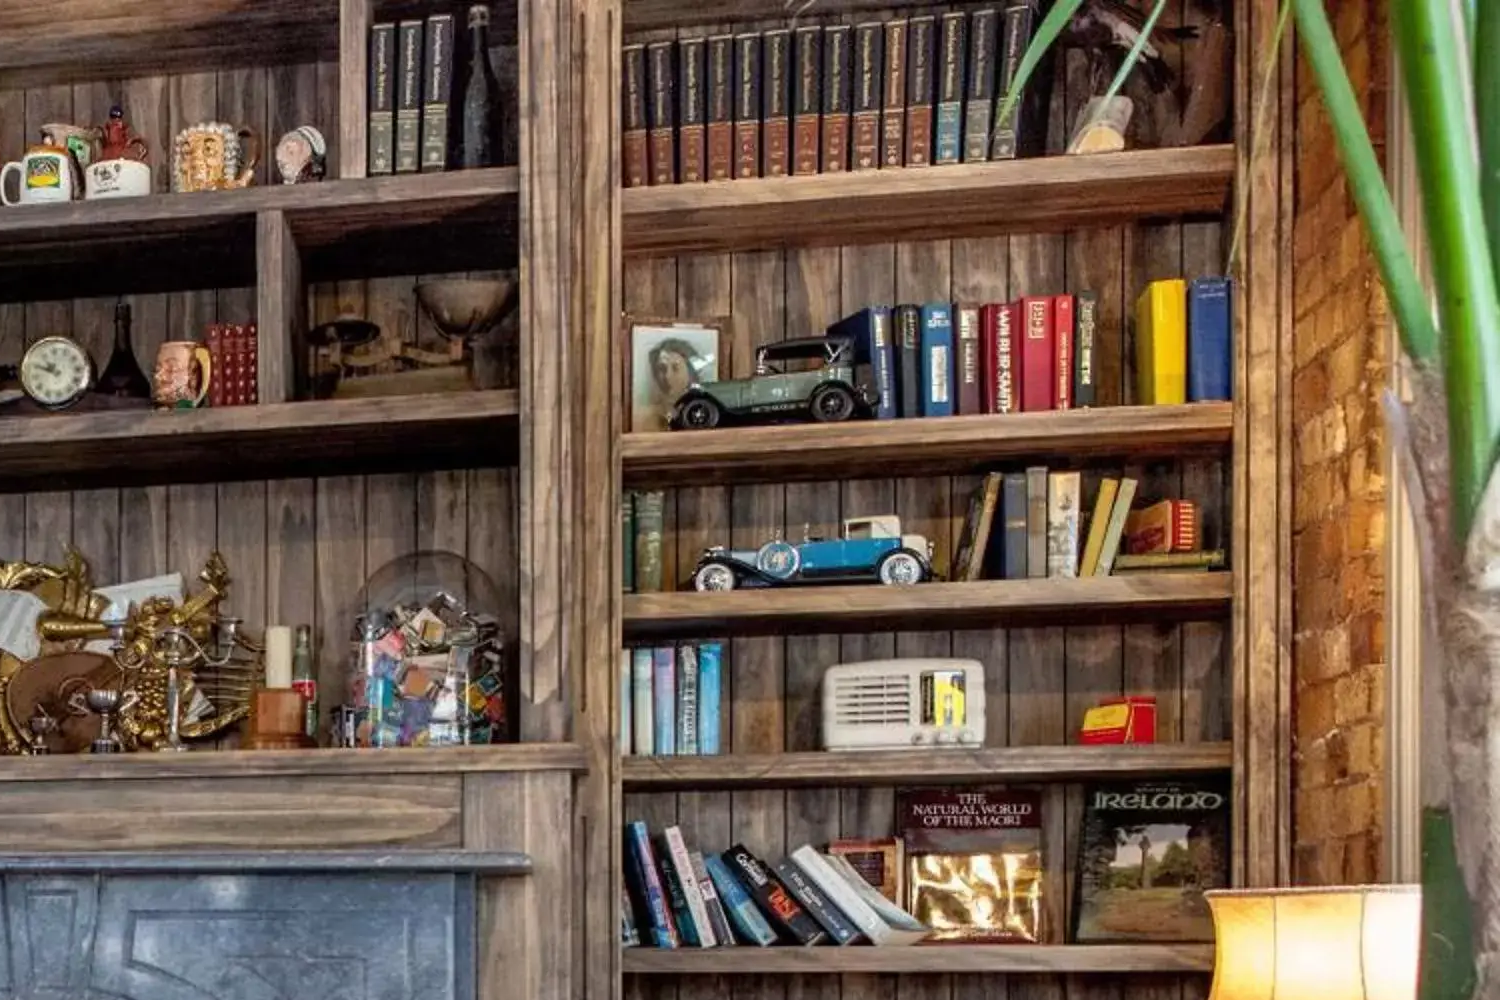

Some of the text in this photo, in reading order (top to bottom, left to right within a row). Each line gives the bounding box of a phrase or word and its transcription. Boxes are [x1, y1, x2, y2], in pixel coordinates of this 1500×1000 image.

[957, 793, 986, 804] THE
[913, 803, 1032, 815] NATURAL WORLD
[923, 815, 1021, 826] OF THE MAORI
